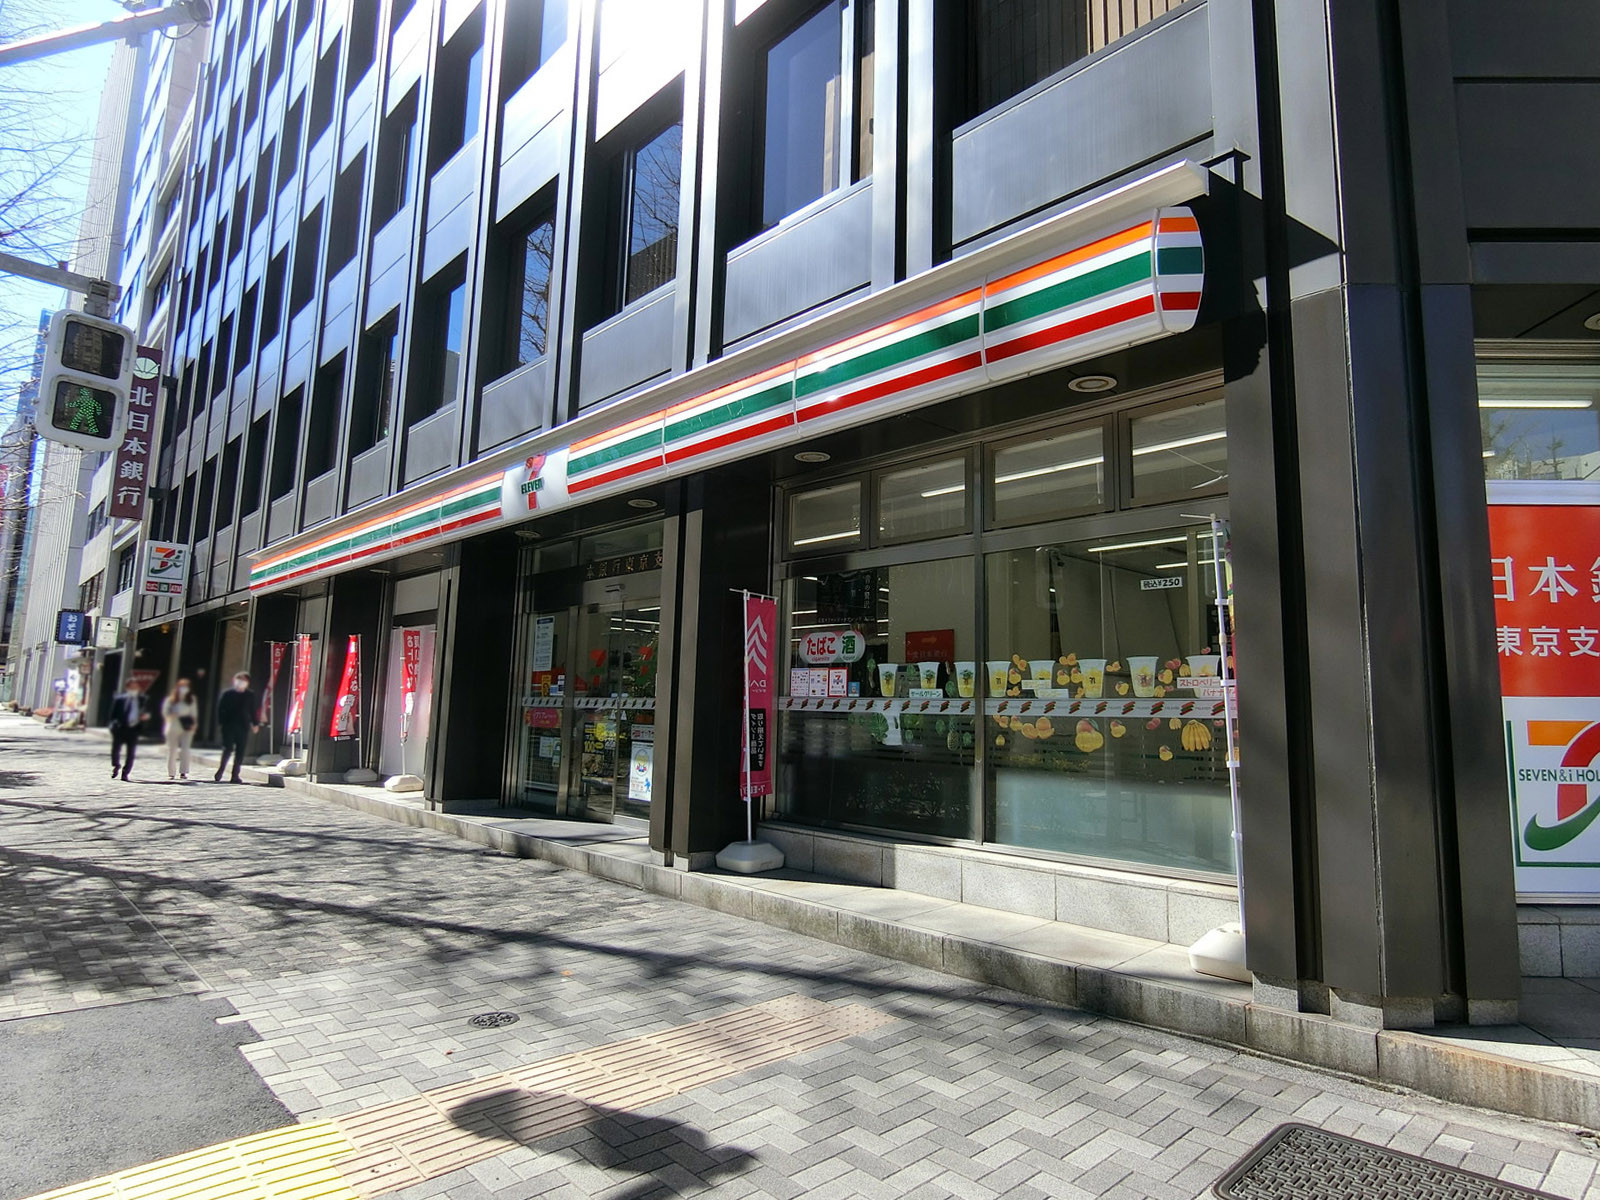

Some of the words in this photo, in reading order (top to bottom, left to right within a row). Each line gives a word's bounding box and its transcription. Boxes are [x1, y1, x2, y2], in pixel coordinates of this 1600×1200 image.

[116, 385, 154, 506] 北日本銀行
[65, 613, 78, 640] おそば
[806, 636, 836, 656] たばこ
[841, 635, 856, 654] 酒
